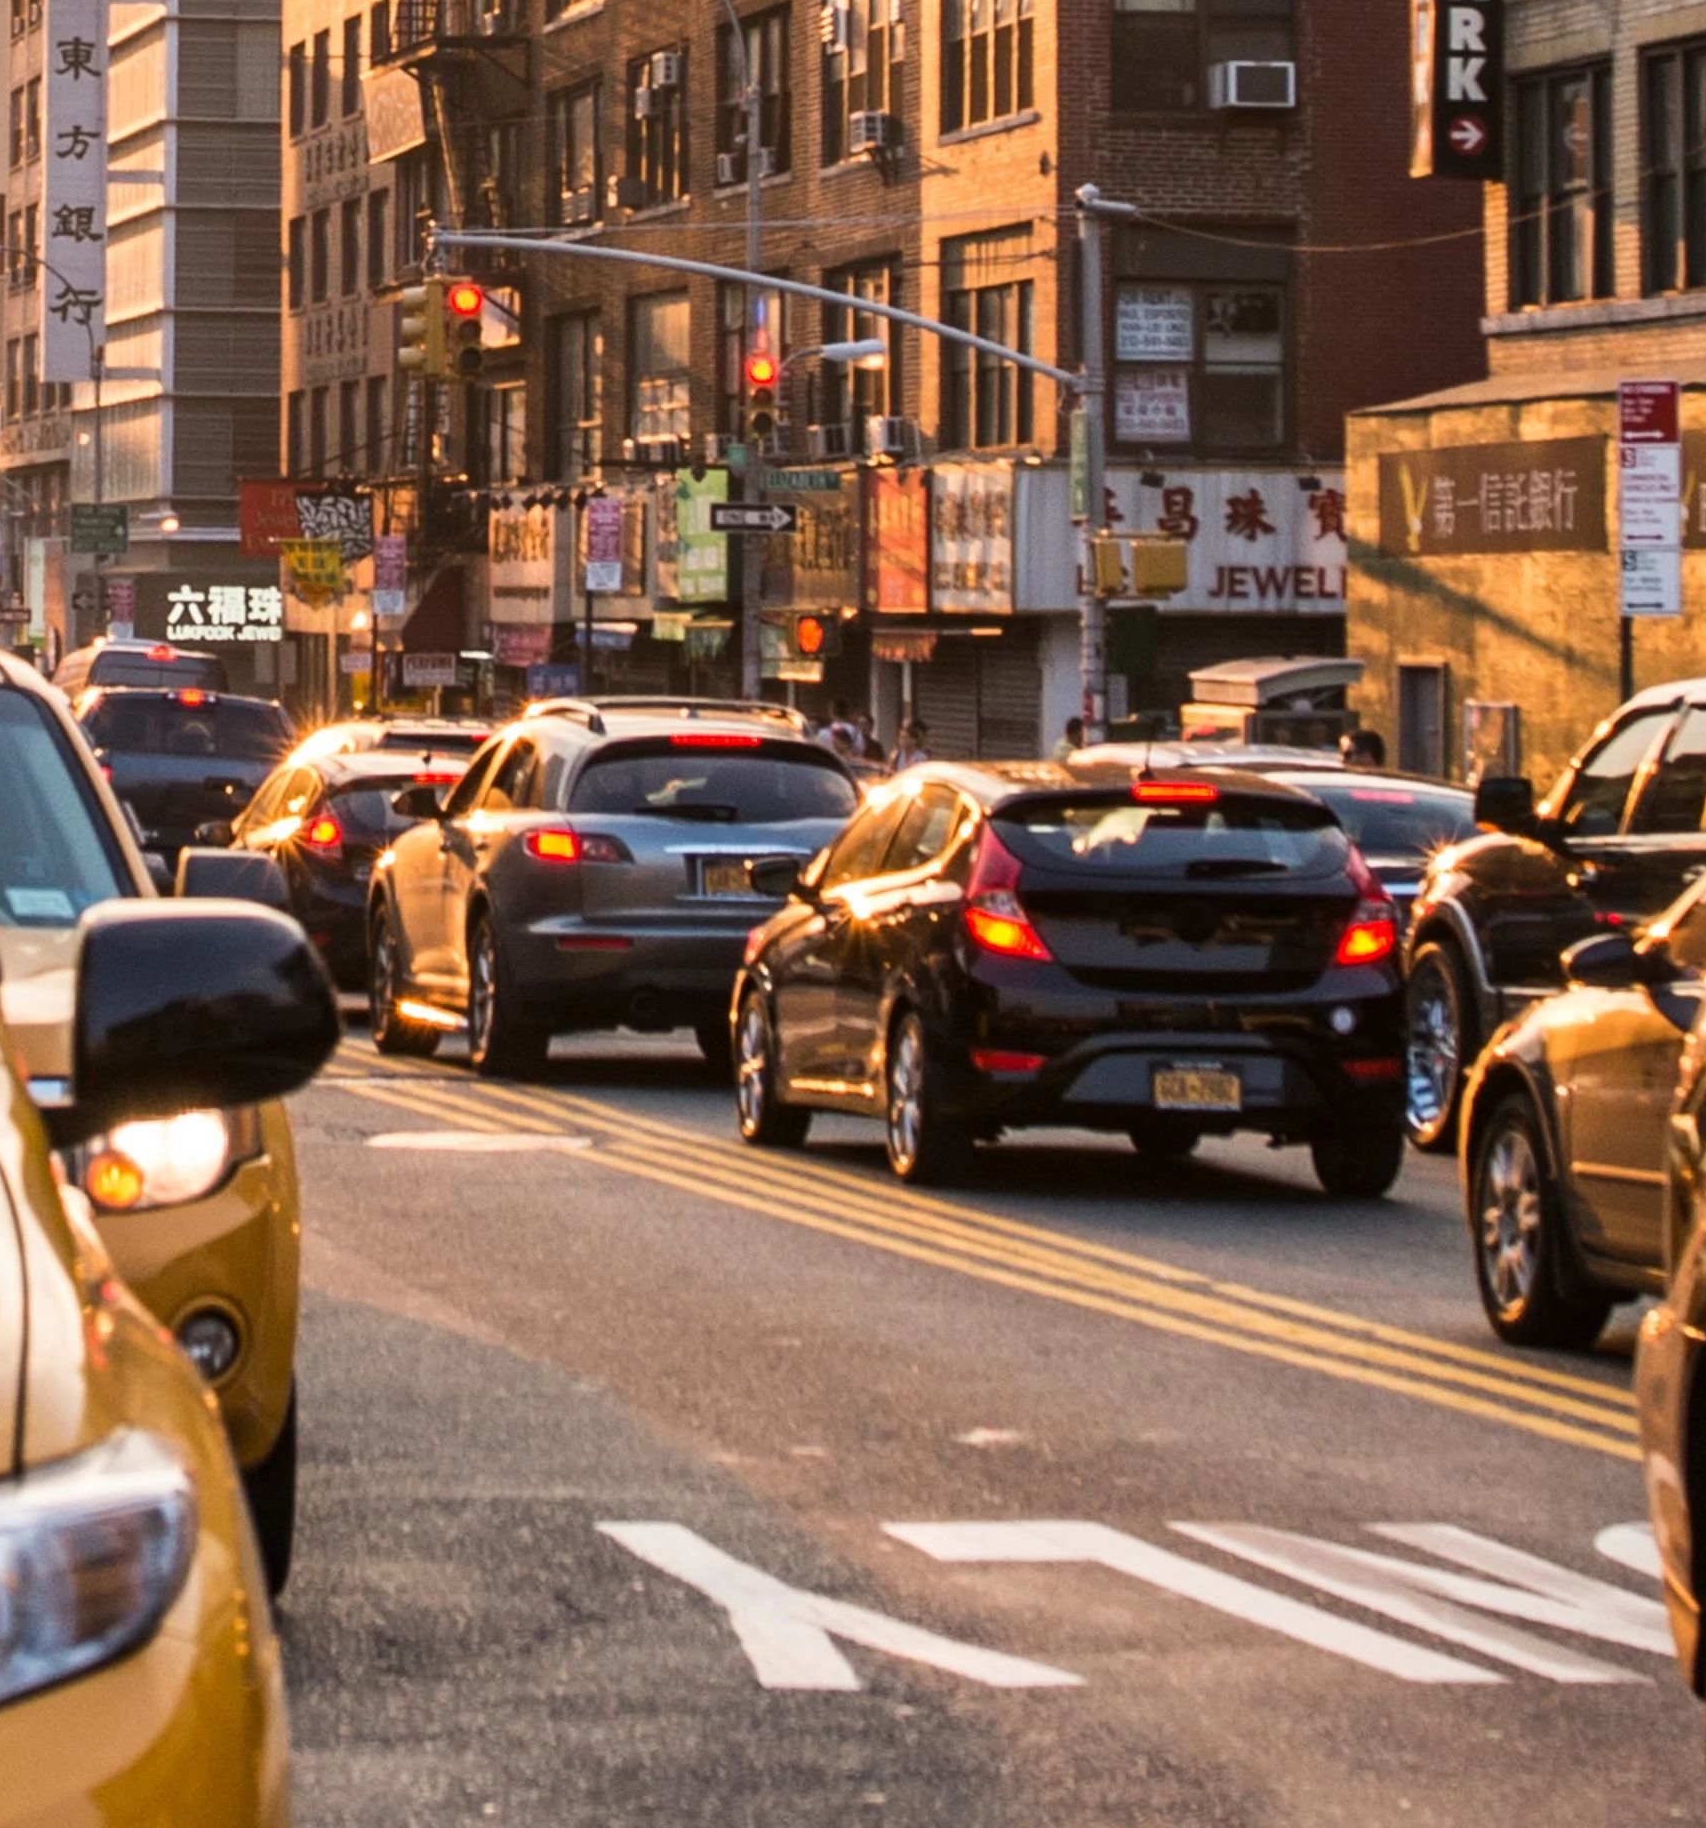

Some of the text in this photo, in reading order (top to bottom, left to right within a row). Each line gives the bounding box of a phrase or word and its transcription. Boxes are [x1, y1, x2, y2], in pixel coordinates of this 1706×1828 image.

[50, 37, 103, 325] 東方銀行
[1433, 469, 1578, 539] 第一信託銀行
[166, 583, 282, 626] 六福珠
